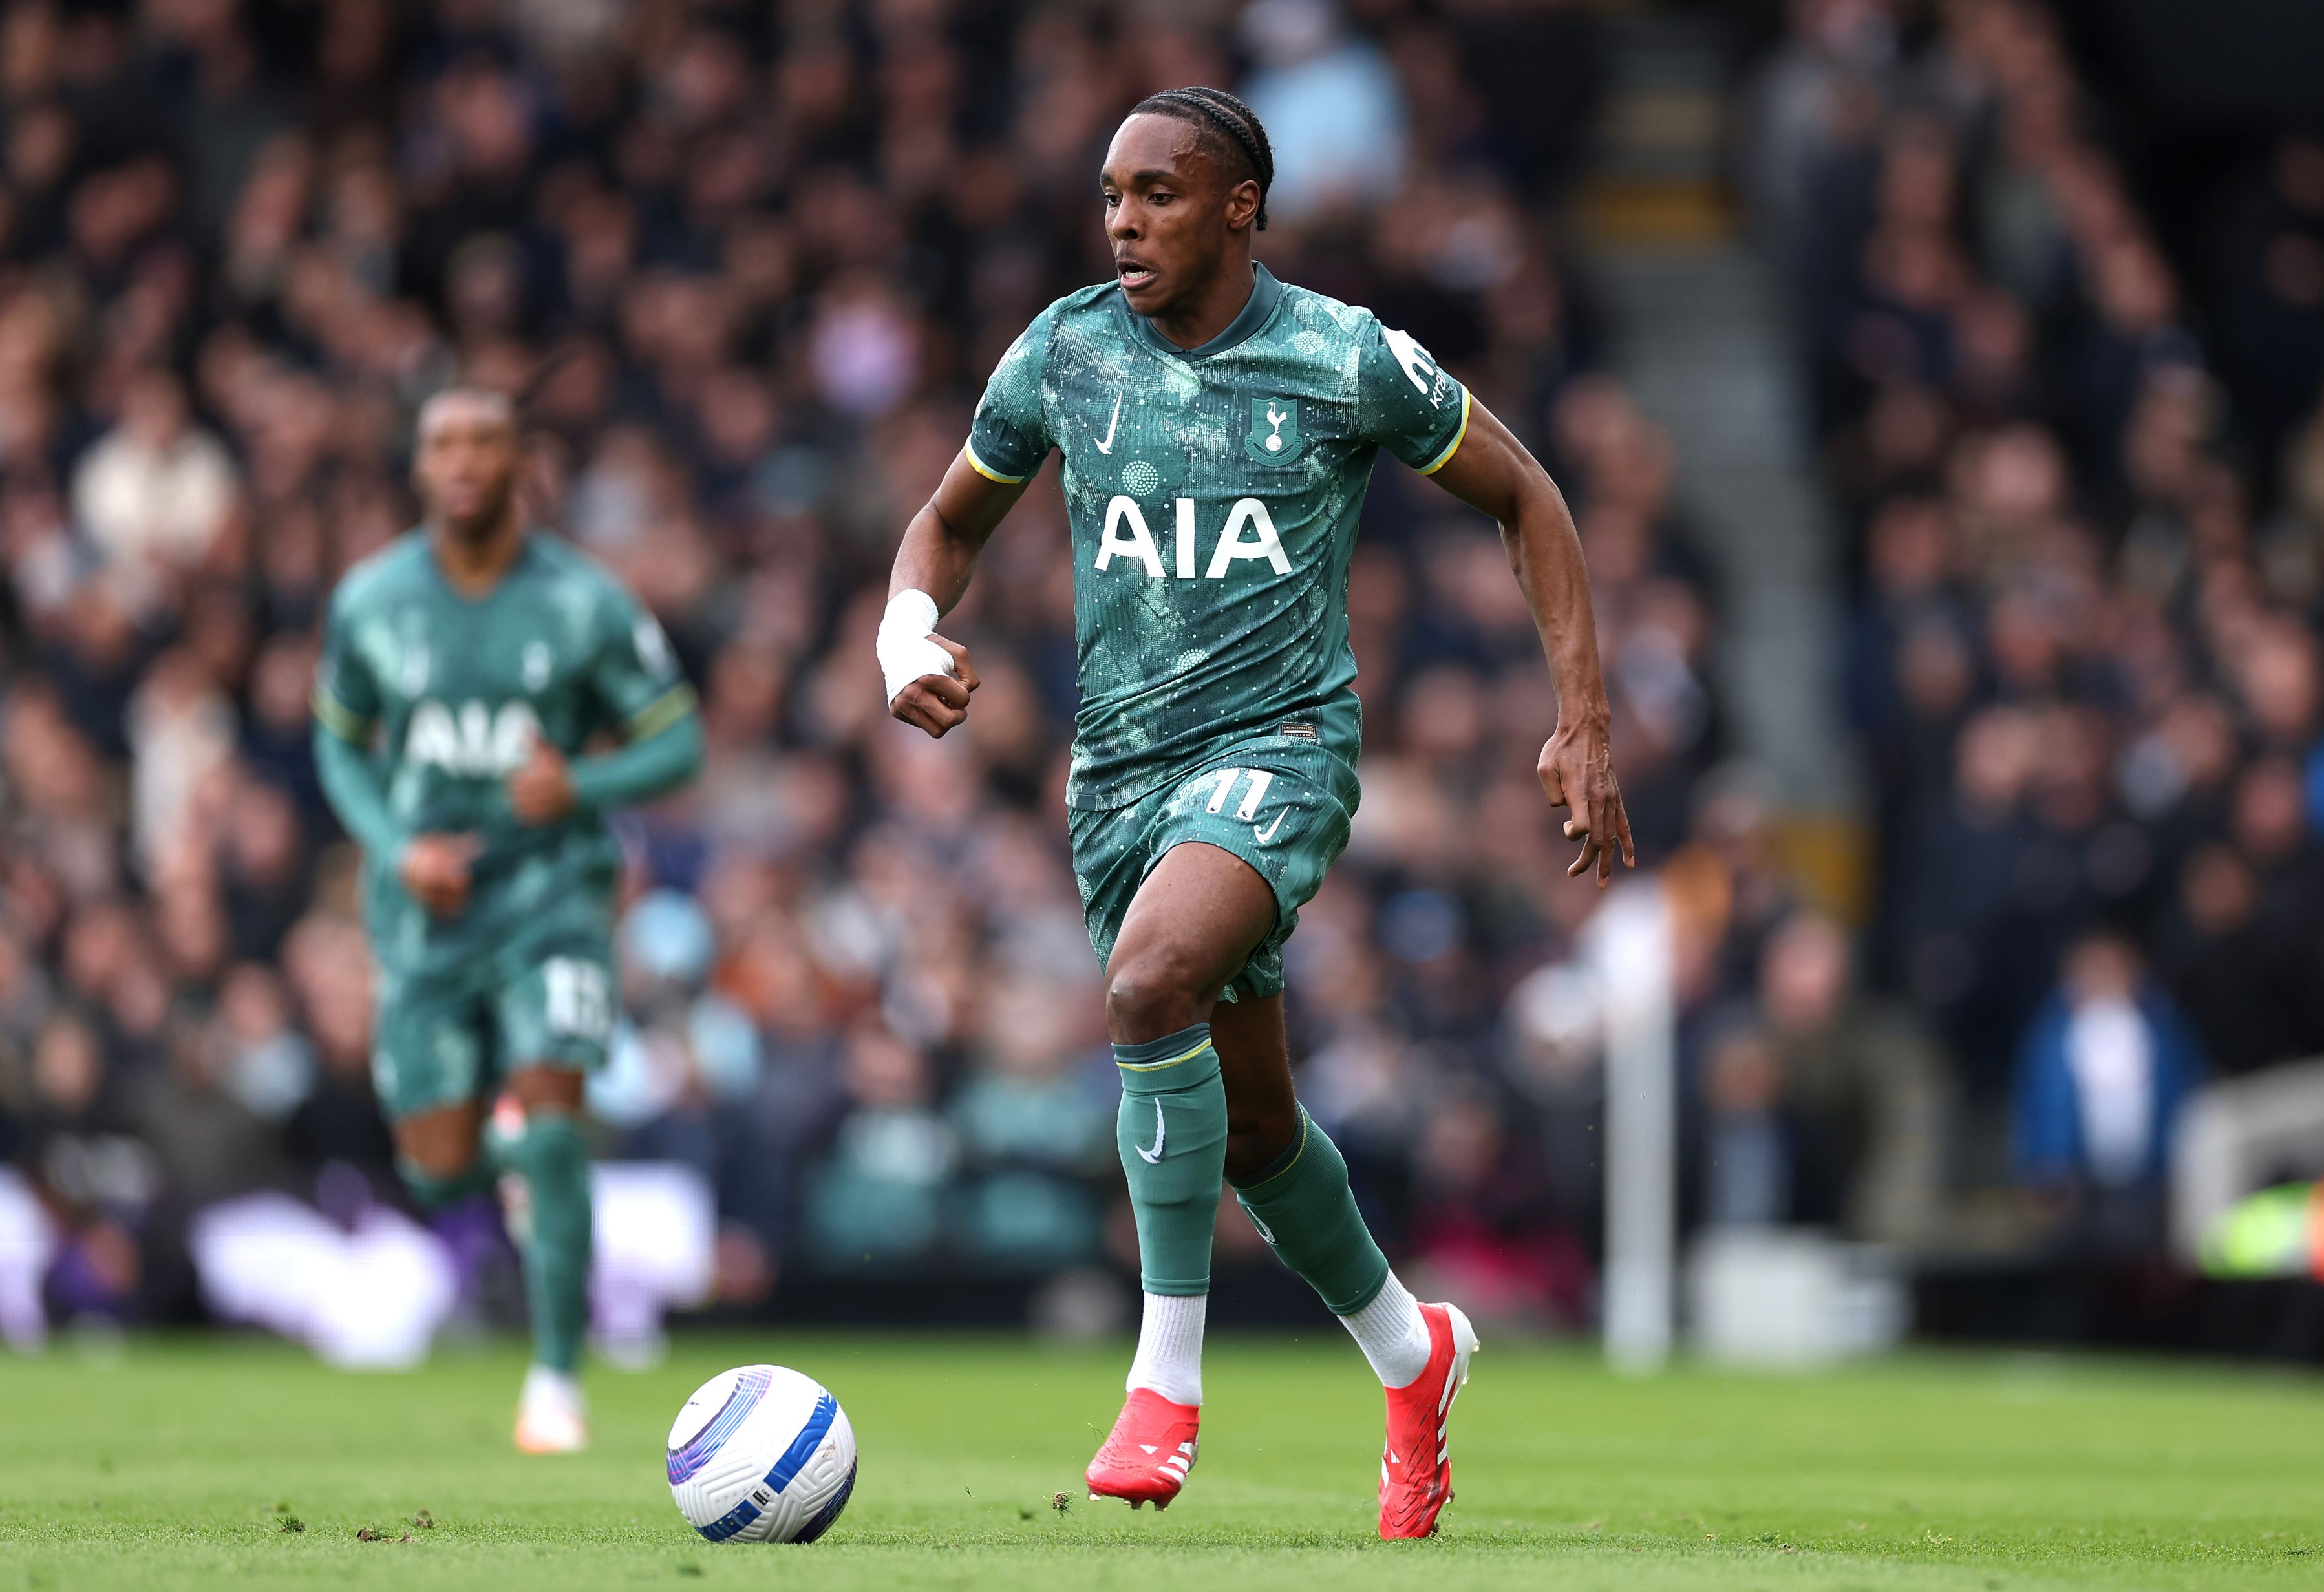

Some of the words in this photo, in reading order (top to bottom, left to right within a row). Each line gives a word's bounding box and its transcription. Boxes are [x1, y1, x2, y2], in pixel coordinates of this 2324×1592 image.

[1094, 495, 1293, 578] AIA
[405, 699, 543, 776] AIA
[1205, 767, 1274, 822] 11
